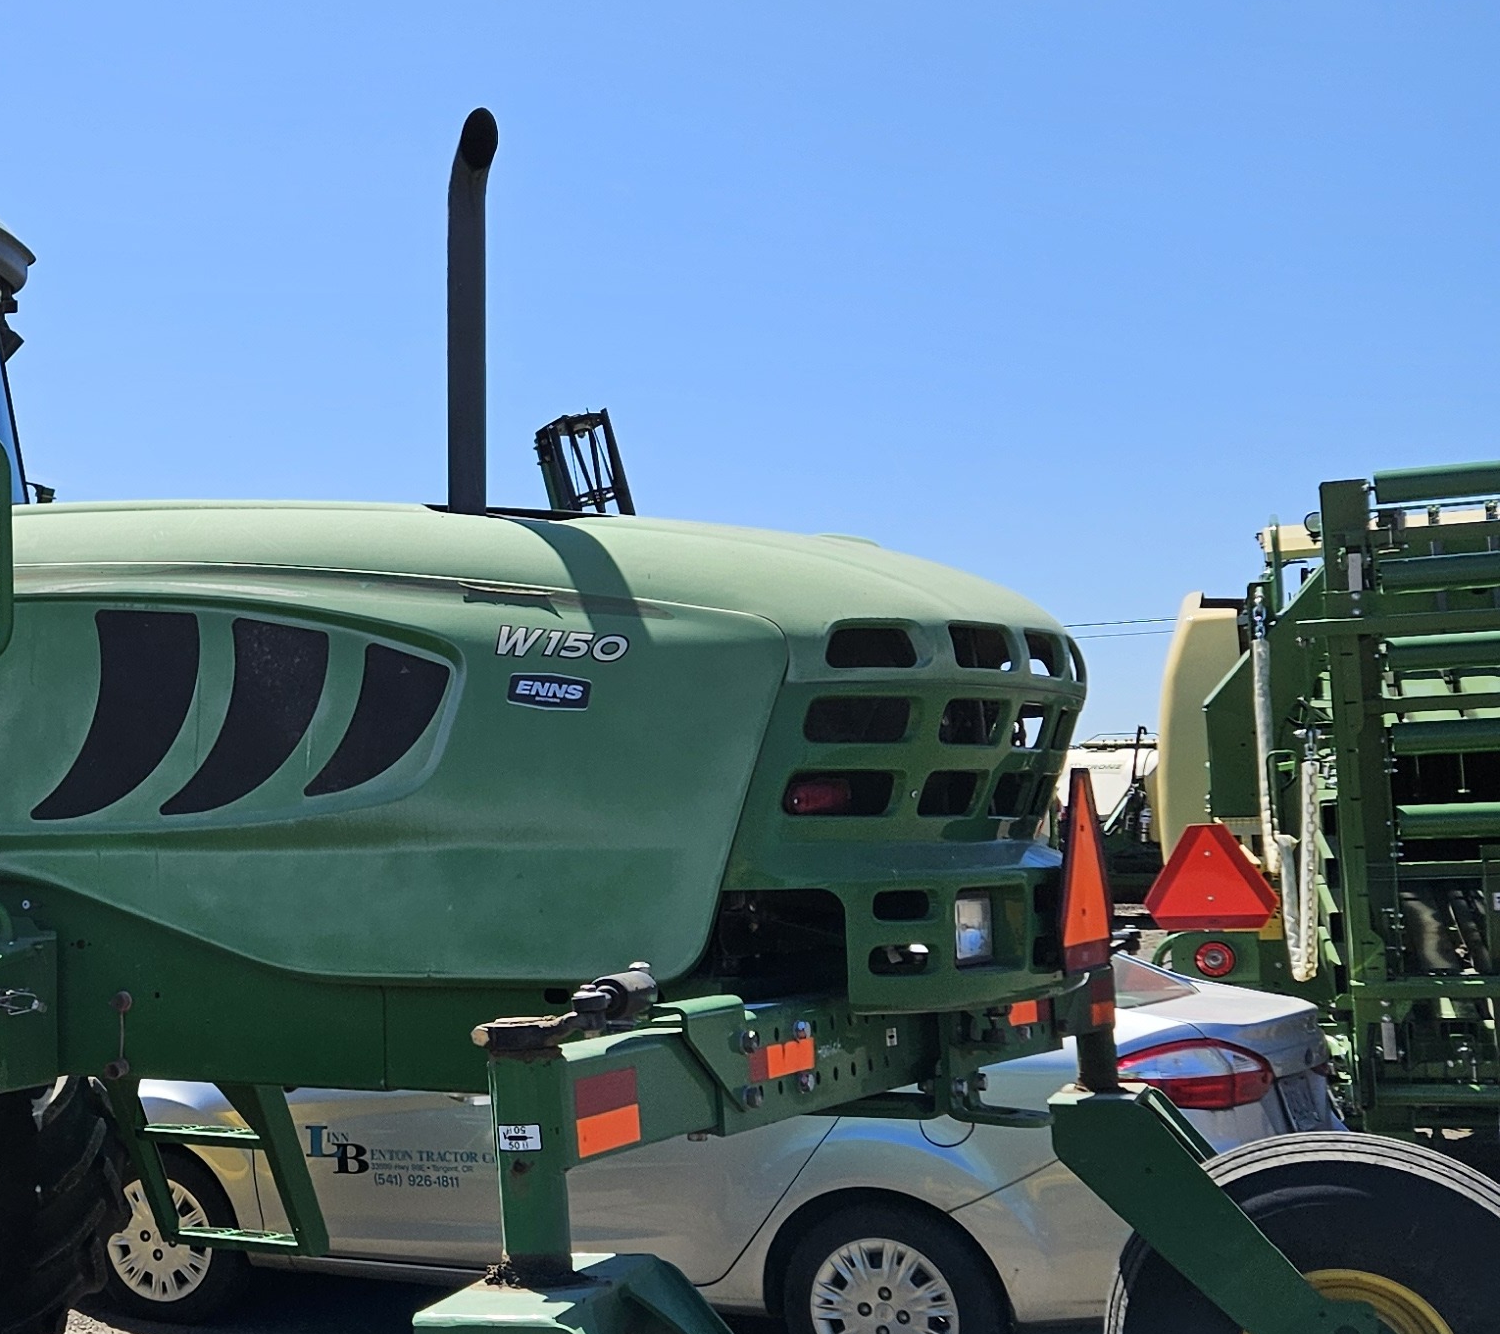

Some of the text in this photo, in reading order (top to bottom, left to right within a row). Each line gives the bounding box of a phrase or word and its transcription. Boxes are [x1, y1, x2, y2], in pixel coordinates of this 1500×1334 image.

[495, 624, 629, 663] W150
[515, 679, 584, 701] ENNS
[417, 1150, 479, 1163] TRACTOR
[373, 1172, 460, 1189] (541) 926-1811
